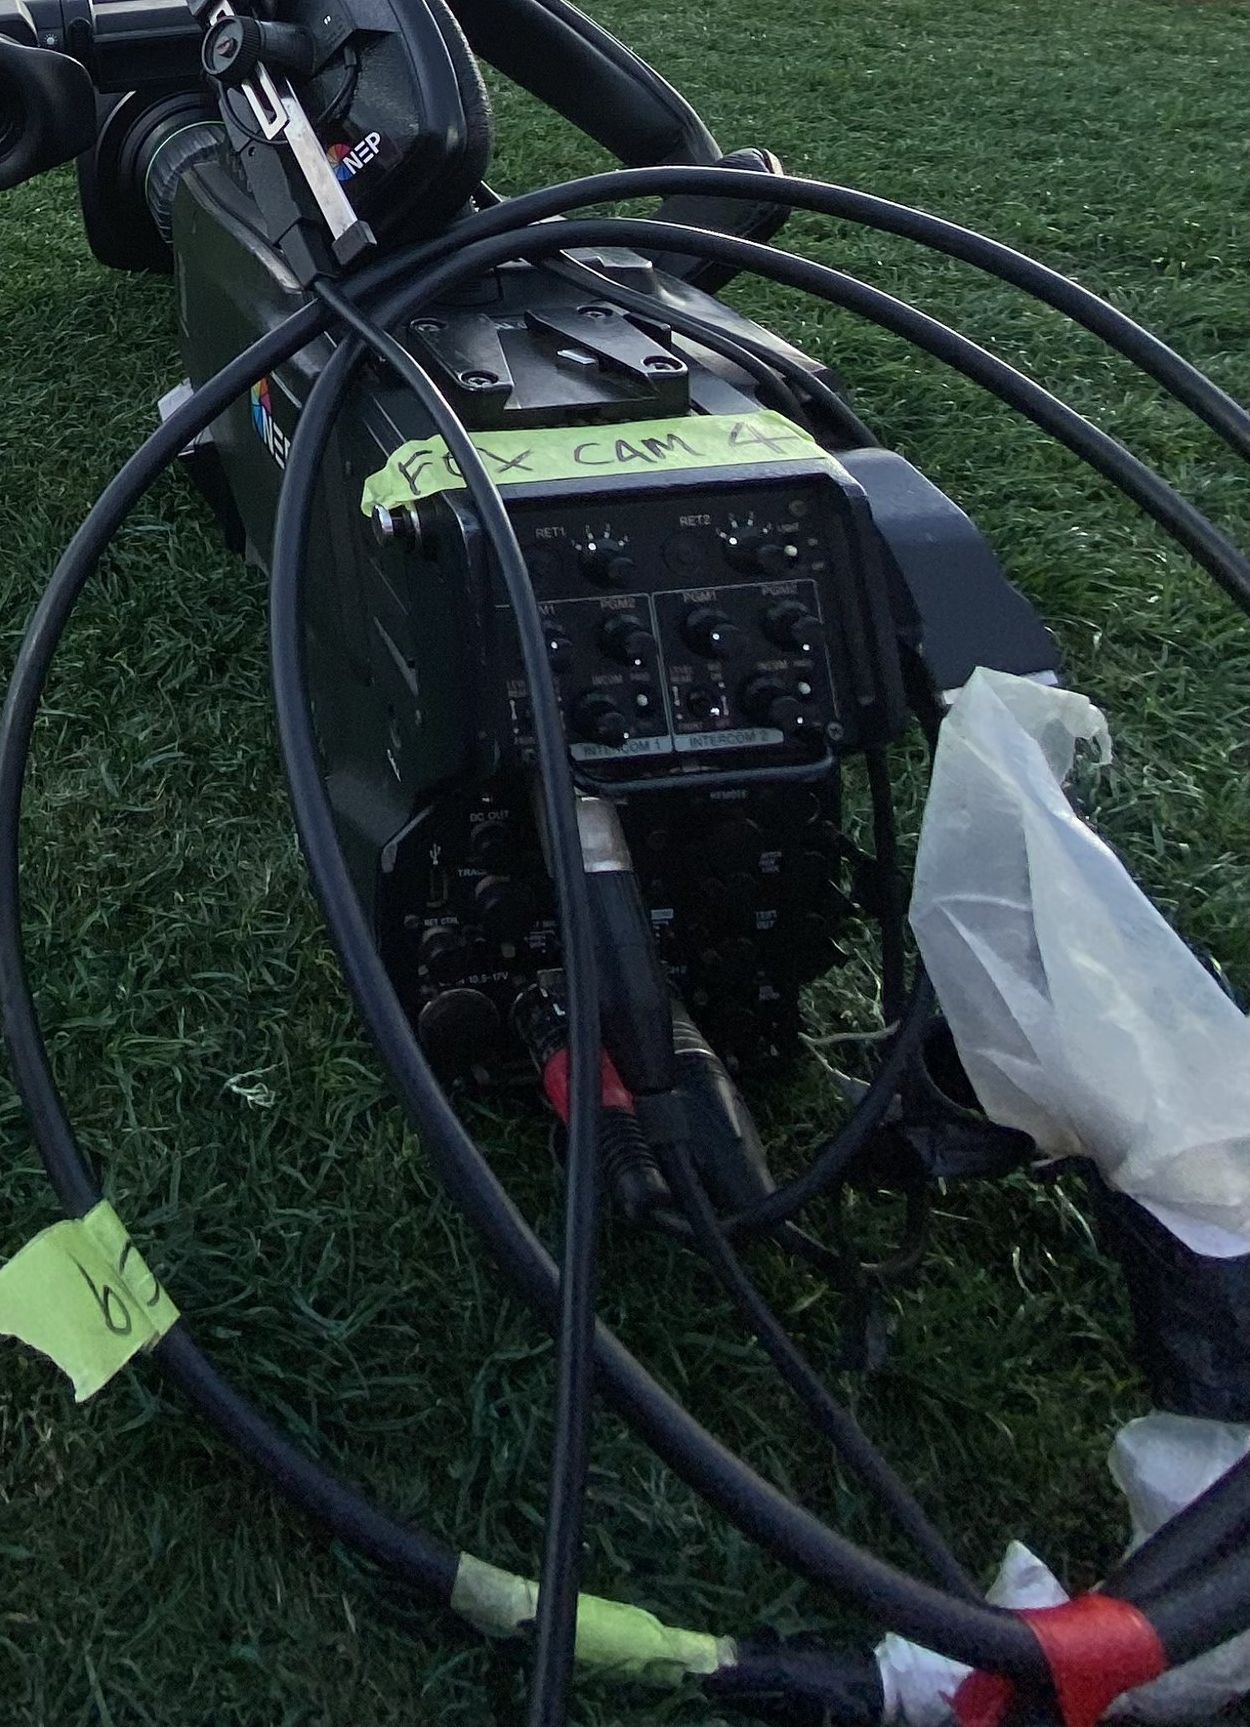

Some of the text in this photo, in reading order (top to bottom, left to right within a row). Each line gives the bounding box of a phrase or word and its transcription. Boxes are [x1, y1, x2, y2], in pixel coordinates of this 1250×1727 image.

[342, 131, 381, 175] NEP
[573, 432, 703, 466] CAM
[727, 418, 799, 455] 4
[535, 526, 567, 539] RET1
[689, 730, 756, 748] INTERCOM
